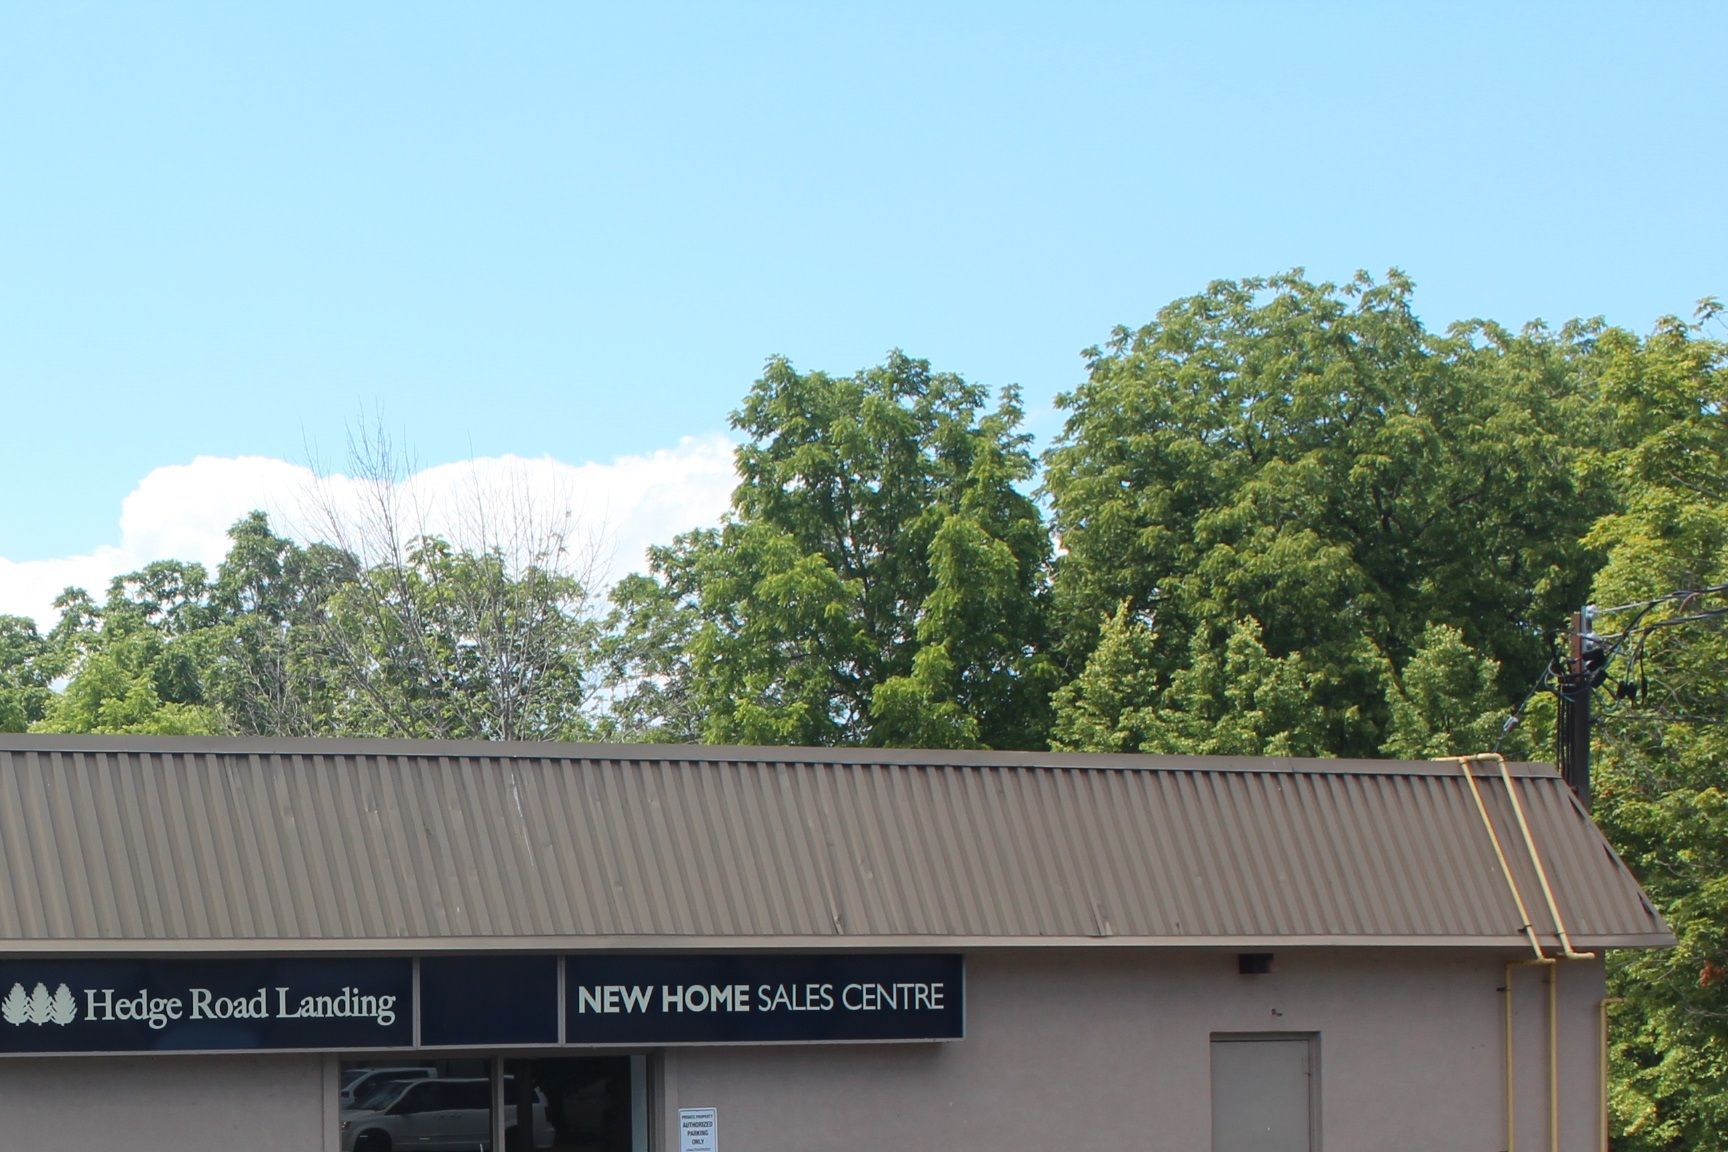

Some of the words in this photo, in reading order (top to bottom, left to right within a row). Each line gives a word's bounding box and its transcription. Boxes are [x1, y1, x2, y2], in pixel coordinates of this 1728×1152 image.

[84, 988, 183, 1030] Hedge
[189, 987, 270, 1020] Road
[275, 986, 397, 1026] Landing
[578, 985, 654, 1014] NEW
[662, 984, 750, 1013] HOME
[757, 983, 834, 1012] SALES
[842, 982, 945, 1011] CENTRE
[683, 1121, 714, 1129] AUTHORIZED
